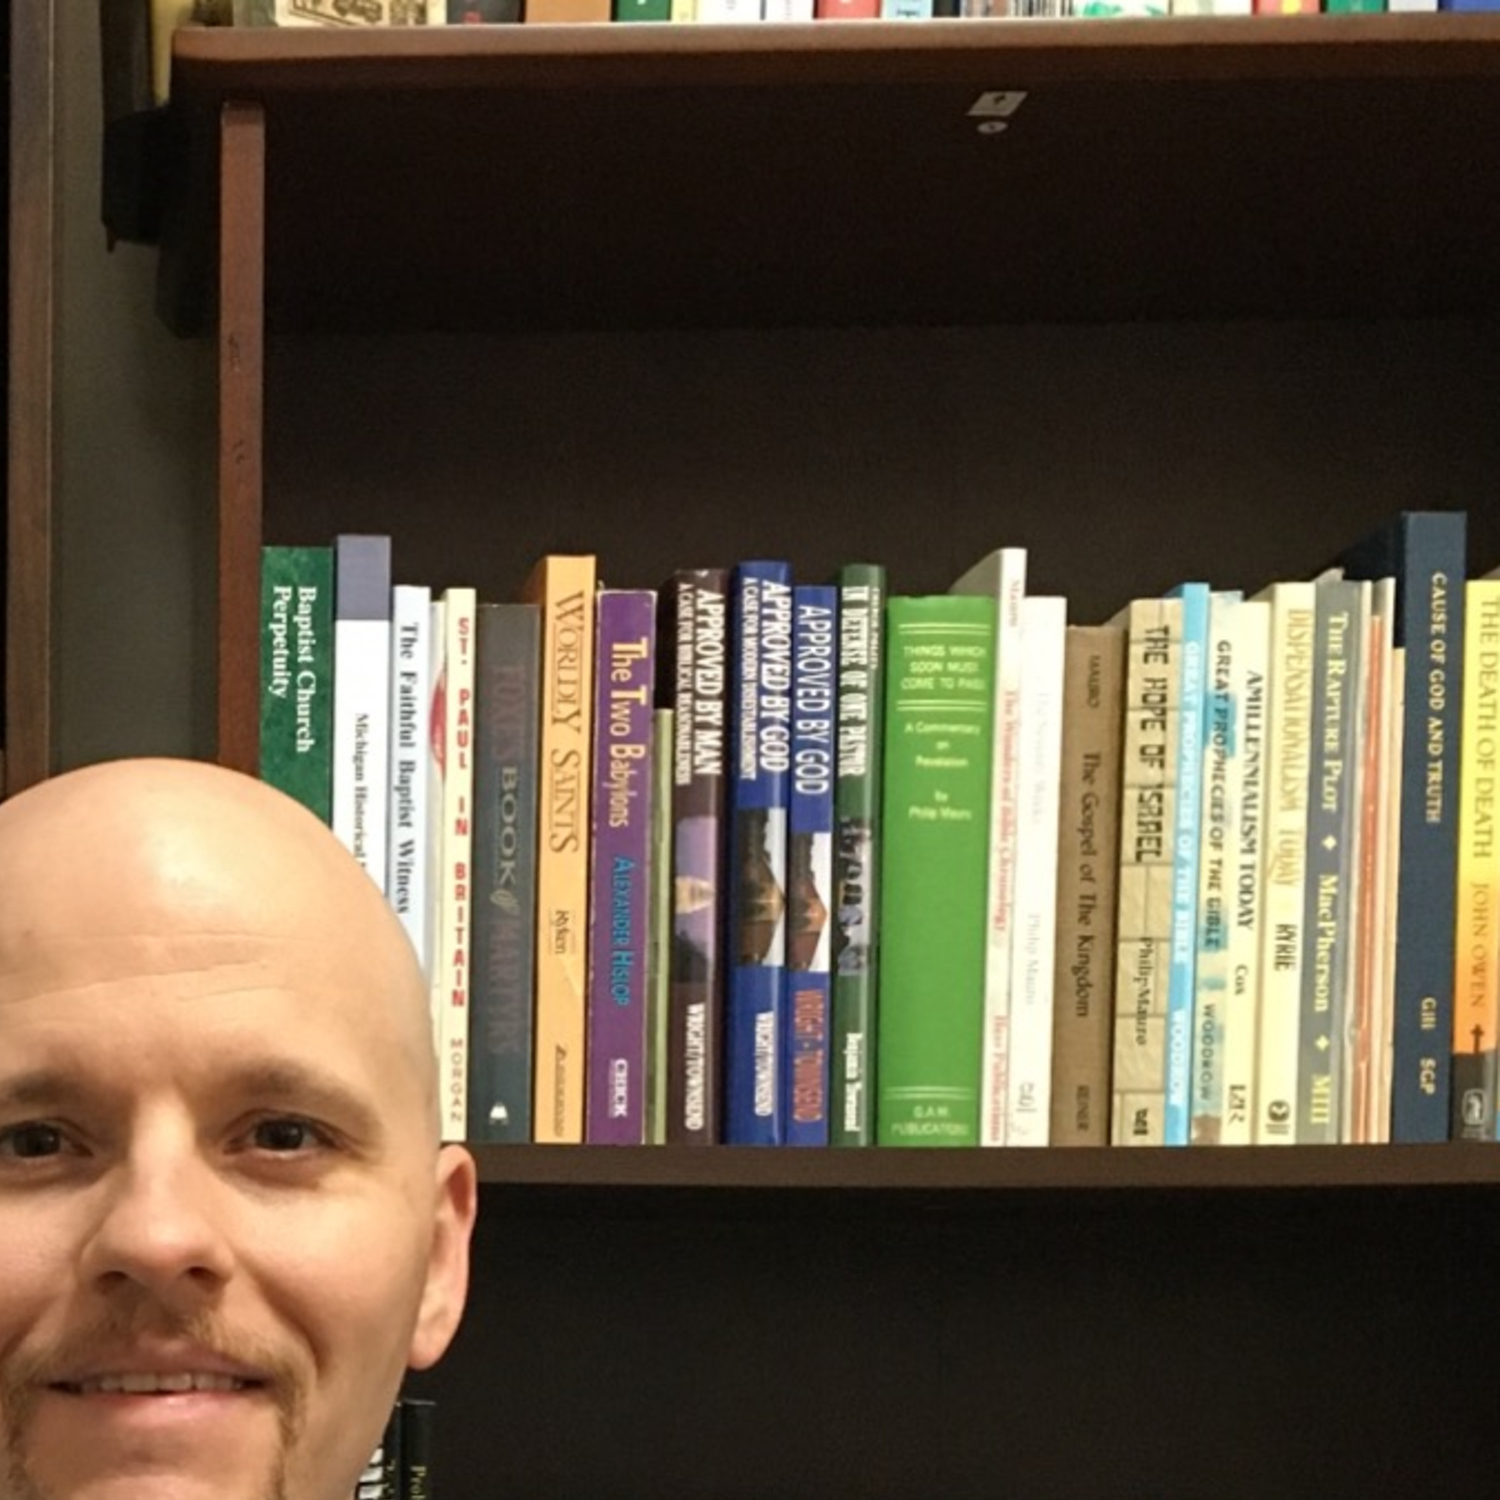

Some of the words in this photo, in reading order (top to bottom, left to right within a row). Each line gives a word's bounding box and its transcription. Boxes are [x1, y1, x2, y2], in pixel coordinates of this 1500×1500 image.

[294, 586, 317, 662] Baptist
[761, 580, 791, 690] APPROVED
[1430, 572, 1447, 635] CAUSE
[1480, 598, 1500, 645] THE
[268, 586, 292, 698] Perpetuity
[400, 622, 418, 659] The
[552, 590, 585, 734] WORLDLY
[611, 637, 648, 682] The
[695, 589, 725, 695] APPROVED
[797, 605, 832, 712] APPROVED
[1143, 625, 1170, 664] THE
[1328, 612, 1349, 660] THE
[1430, 640, 1446, 664] OF
[1214, 640, 1231, 702] GREAT
[1428, 670, 1445, 710] GOD
[1477, 651, 1500, 732] DEATH
[296, 670, 317, 753] Church
[400, 671, 417, 748] Faithful
[457, 688, 471, 769] PAUL
[609, 684, 647, 737] Two
[695, 699, 723, 726] BY
[760, 696, 790, 723] BY
[796, 720, 830, 744] BY
[1141, 677, 1167, 731] HOPE
[1324, 660, 1346, 753] RAPTURE
[694, 730, 723, 775] MAN
[759, 726, 790, 772] GOD
[1140, 745, 1165, 769] OF
[1210, 708, 1228, 824] PROPHECIES
[1240, 670, 1263, 854] AMILLENNIALISM
[1427, 717, 1443, 756] AND
[1475, 737, 1496, 768] OF
[393, 760, 416, 828] Baptist
[602, 744, 646, 828] Babylons
[795, 749, 830, 795] GOD
[1082, 753, 1100, 785] The
[1321, 759, 1343, 814] PLOT
[1426, 760, 1442, 823] TRUTH
[455, 796, 468, 836] IN
[501, 767, 518, 885] BOOK
[551, 749, 581, 853] SAINTS
[1077, 792, 1100, 856] Gospel
[1136, 782, 1164, 863] ISRAEL
[1473, 776, 1495, 858] DEATH
[1209, 827, 1224, 849] OF
[397, 839, 415, 914] Witness
[611, 857, 635, 947] ALEXANDER
[1080, 864, 1096, 884] of
[1206, 859, 1222, 890] THE
[1237, 861, 1256, 930] TODAY
[452, 862, 467, 1007] BRITAIN
[1078, 893, 1097, 926] The
[1471, 882, 1490, 936] JOHN
[1315, 874, 1338, 1013] MacPherson
[1471, 941, 1488, 1007] OWEN
[610, 950, 634, 1007] HISLOP
[1071, 935, 1094, 1018] Kingdom
[450, 1039, 463, 1121] MORGAN
[1201, 1004, 1215, 1099] WOODROW
